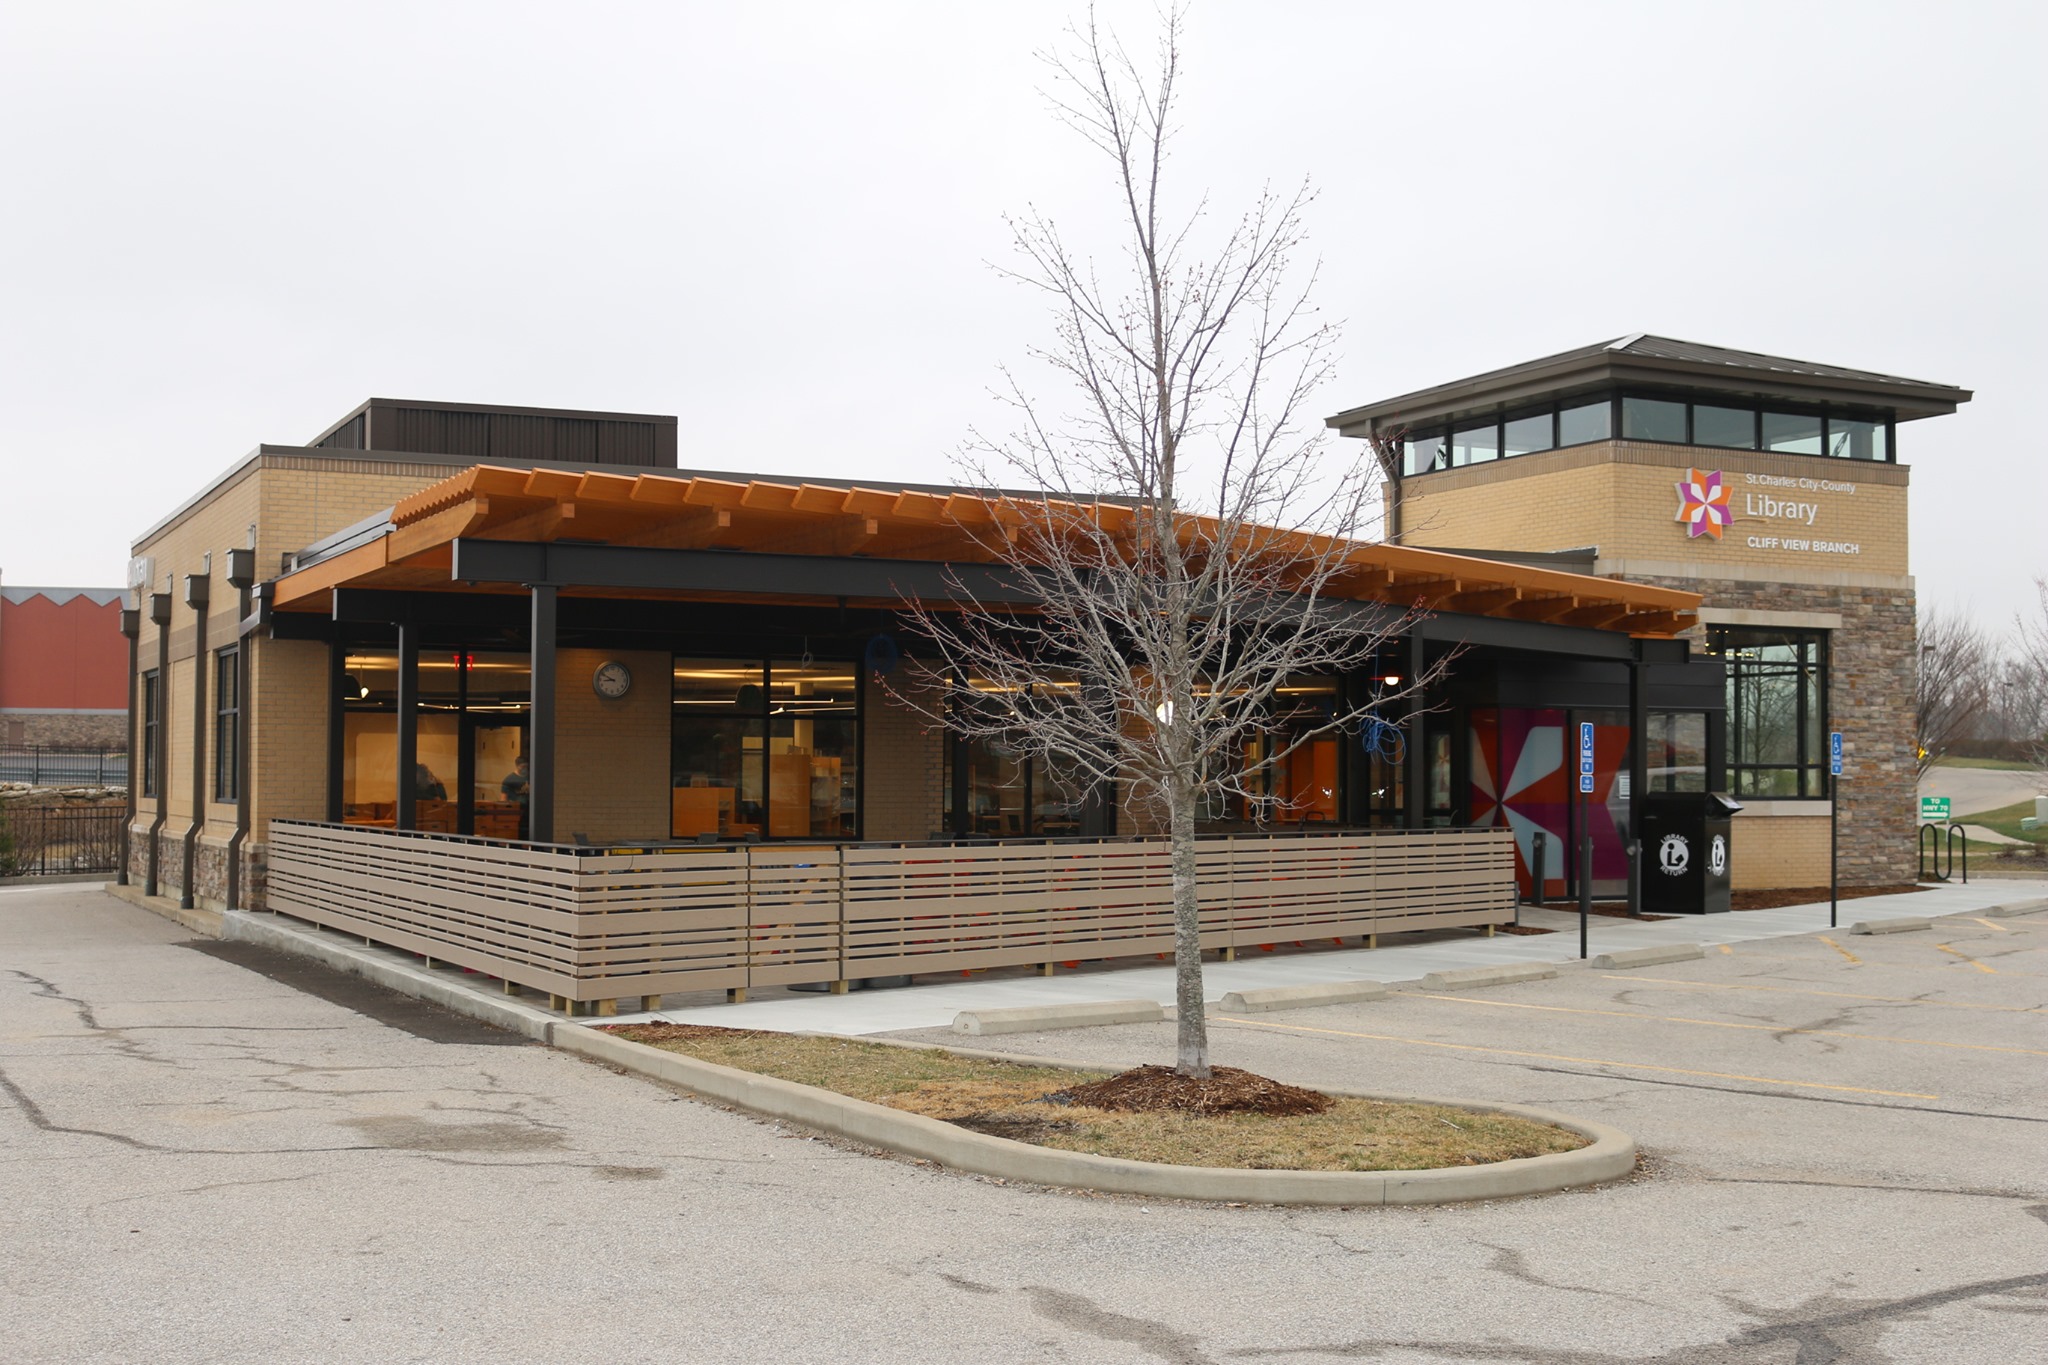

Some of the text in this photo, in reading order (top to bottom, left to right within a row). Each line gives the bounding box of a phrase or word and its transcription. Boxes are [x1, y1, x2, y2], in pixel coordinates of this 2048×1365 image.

[1799, 477, 1855, 494] City-County
[1746, 493, 1818, 525] Library
[1747, 536, 1859, 554] CLIFF VIEW BRANCH
[1660, 833, 1689, 845] LIBRARY
[1660, 865, 1688, 876] RETURN
